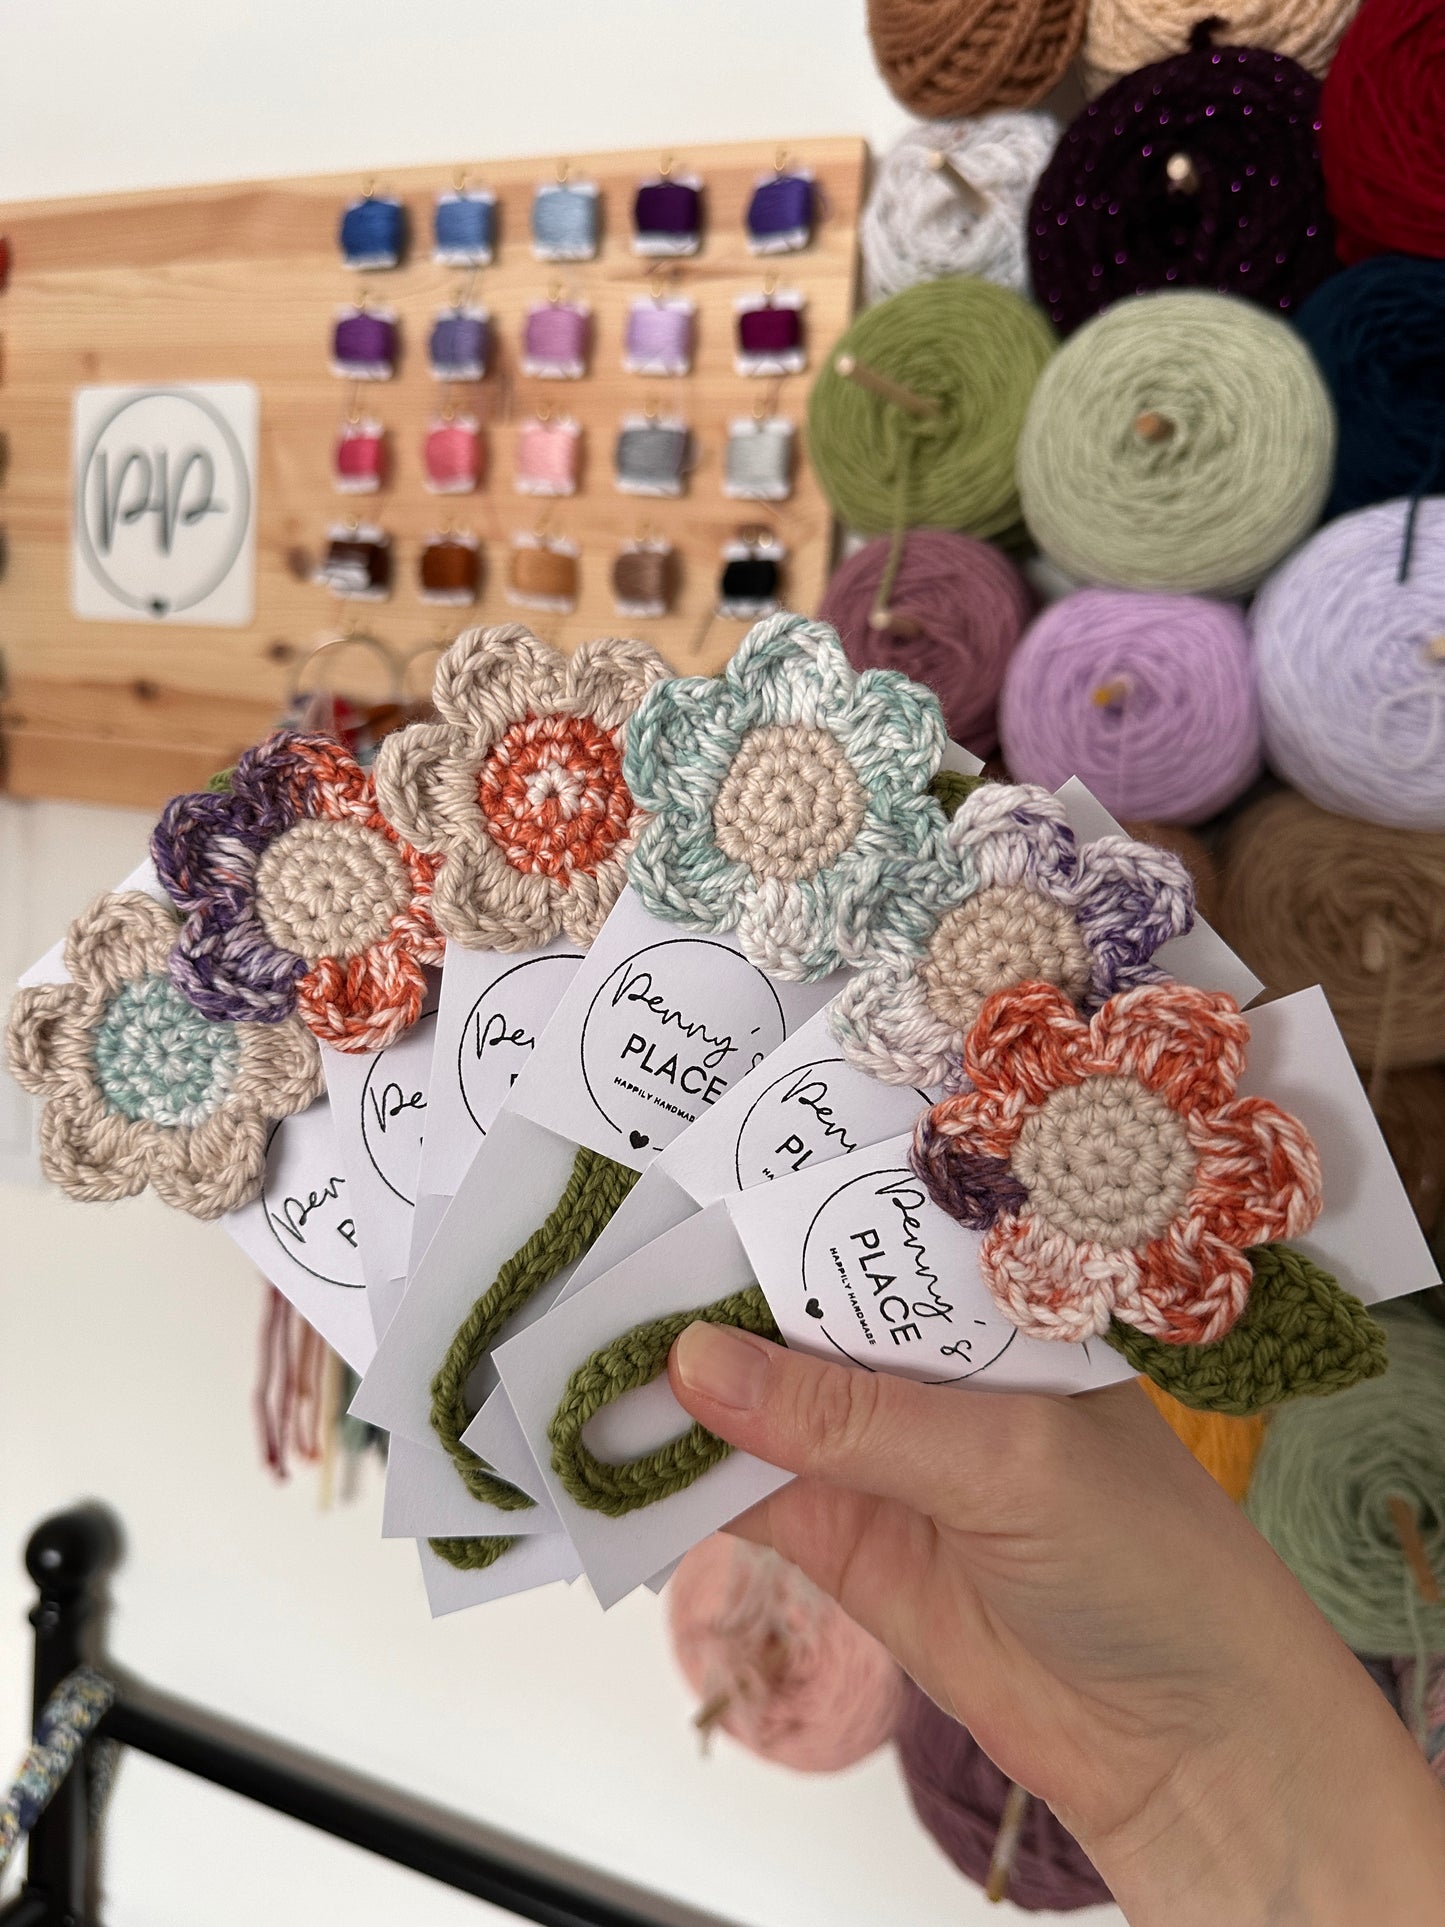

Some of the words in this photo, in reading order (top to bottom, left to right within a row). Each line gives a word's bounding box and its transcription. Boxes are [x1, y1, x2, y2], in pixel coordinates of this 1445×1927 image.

[613, 1076, 653, 1101] HAPPILY
[620, 1033, 728, 1105] PLACE
[829, 1247, 852, 1290] HAPPILY
[848, 1292, 876, 1345] HANDMADE
[850, 1229, 922, 1345] PLACE
[875, 1177, 986, 1362] Penny's
